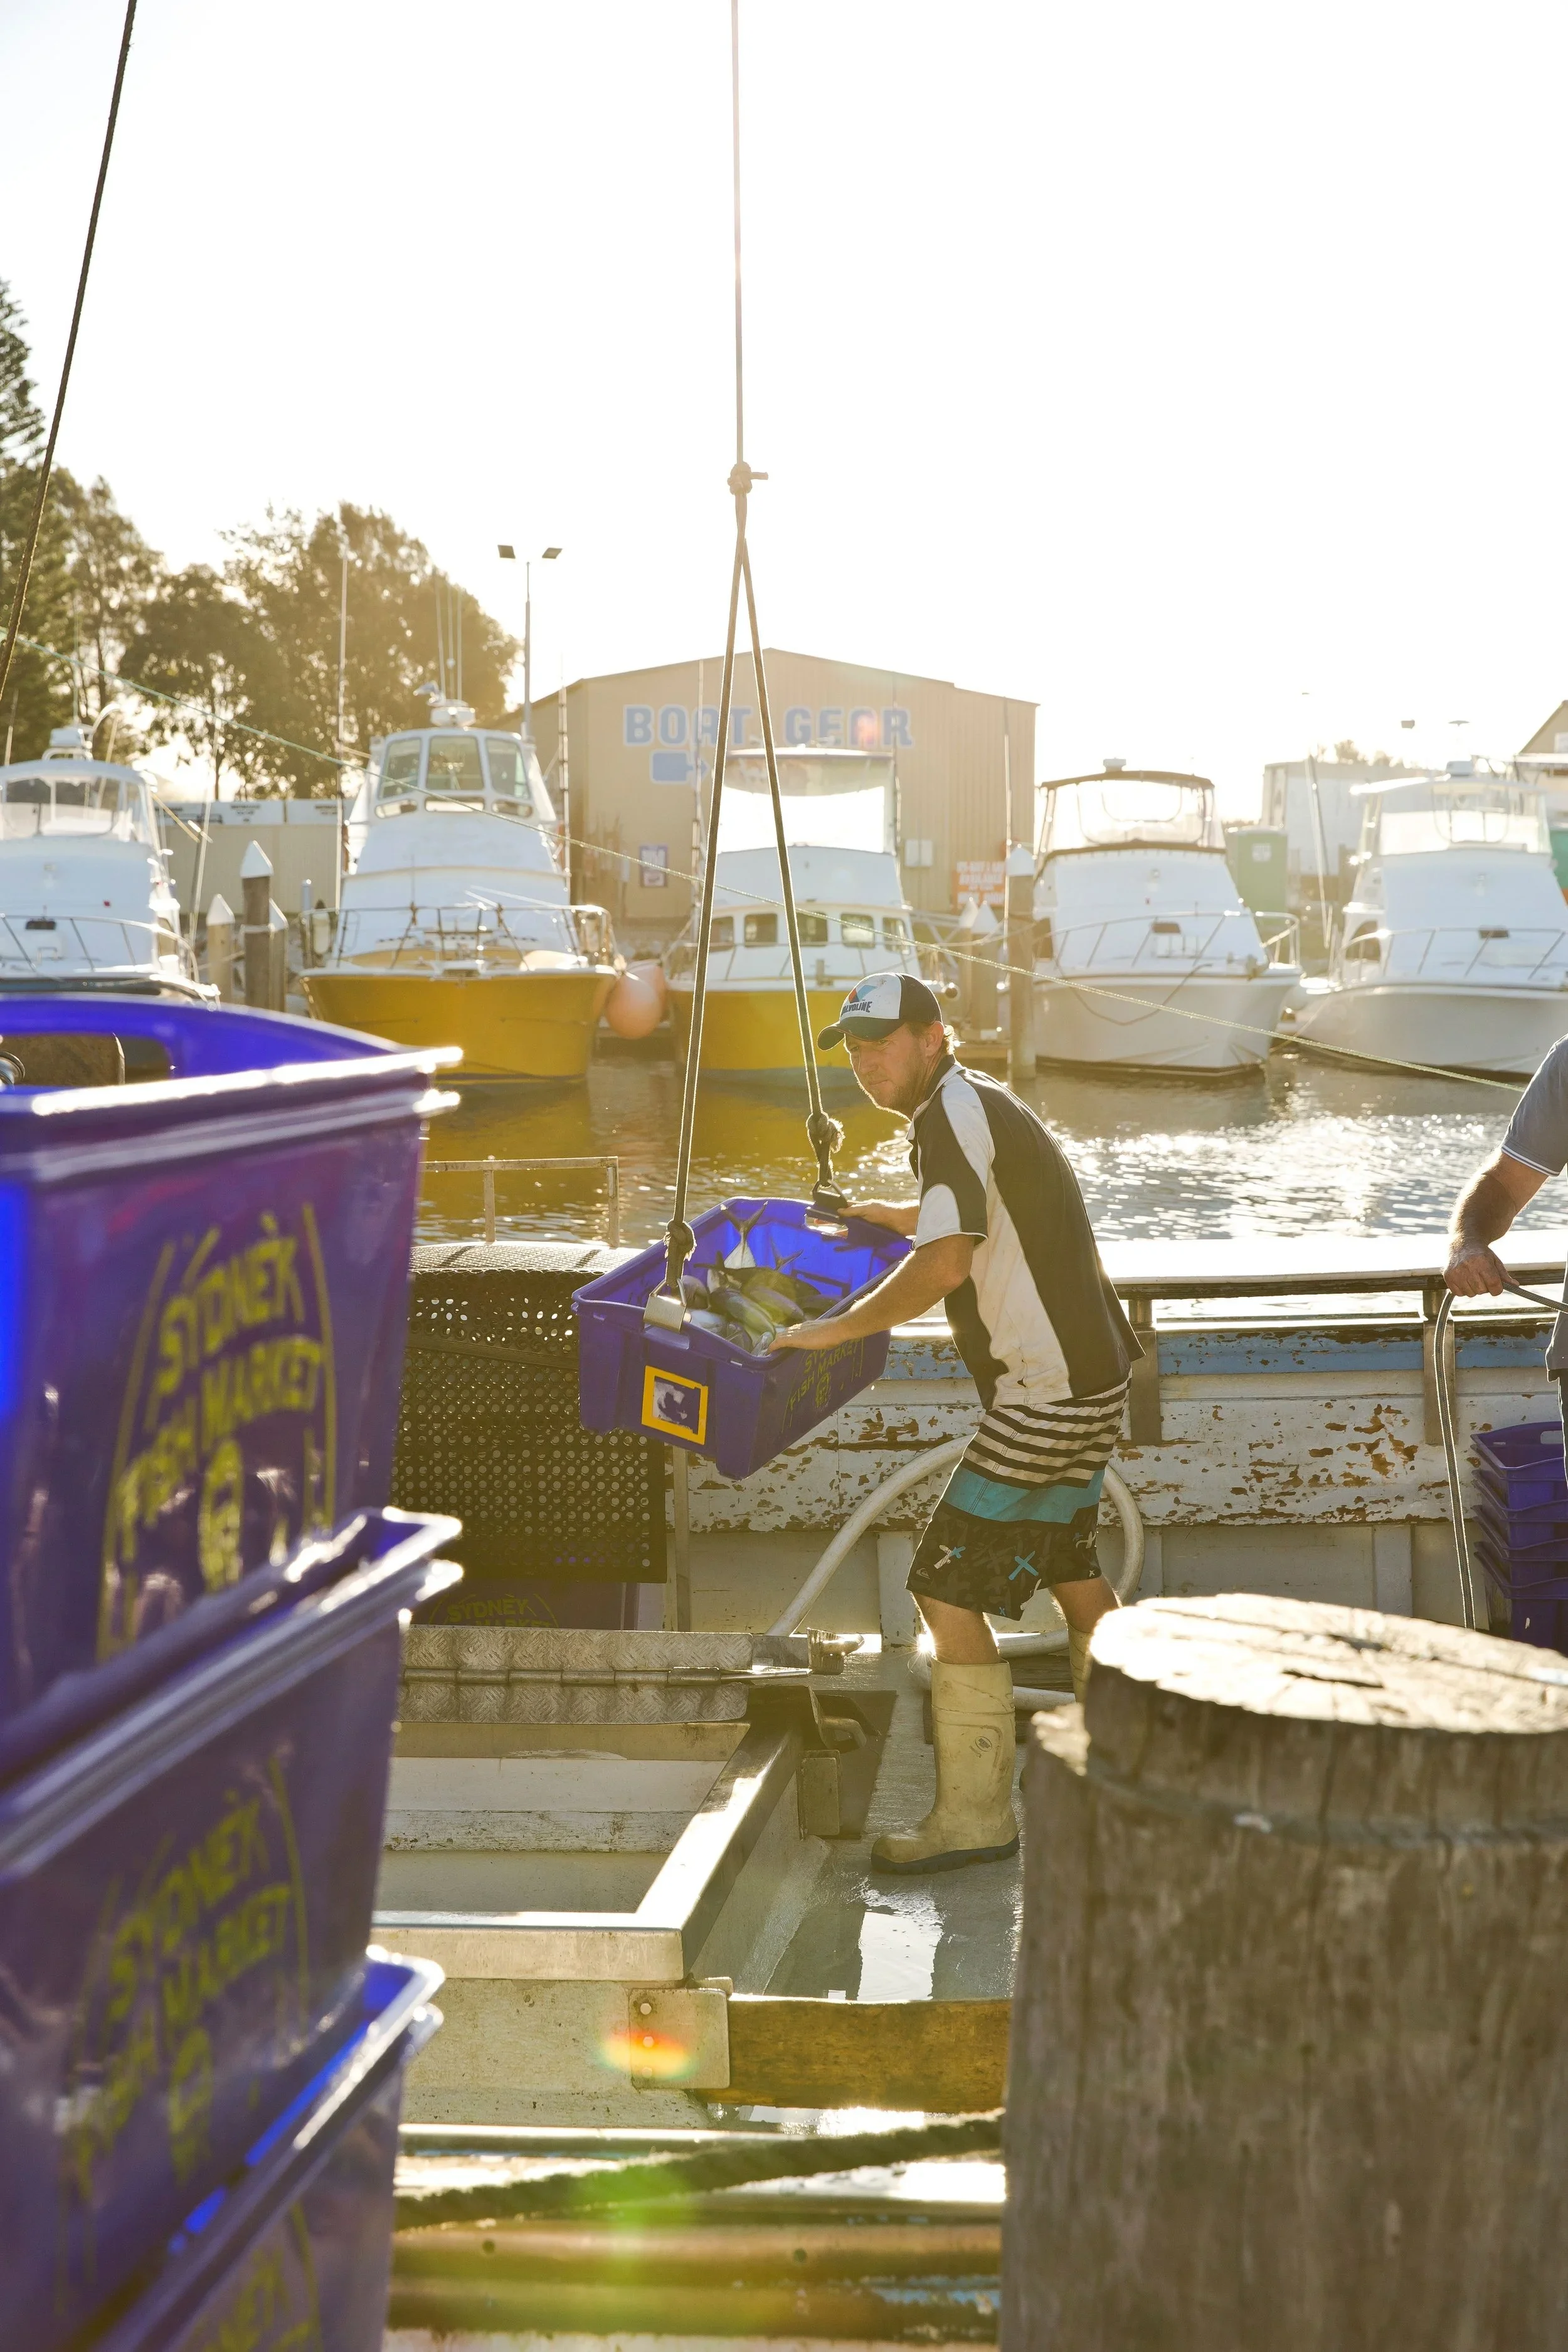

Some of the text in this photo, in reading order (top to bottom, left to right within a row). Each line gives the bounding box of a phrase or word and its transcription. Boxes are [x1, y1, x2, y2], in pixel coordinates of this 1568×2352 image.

[623, 704, 913, 748] BOAT GEAR
[790, 1339, 857, 1411] FISH MARKET
[447, 1599, 529, 1623] SYDNEY
